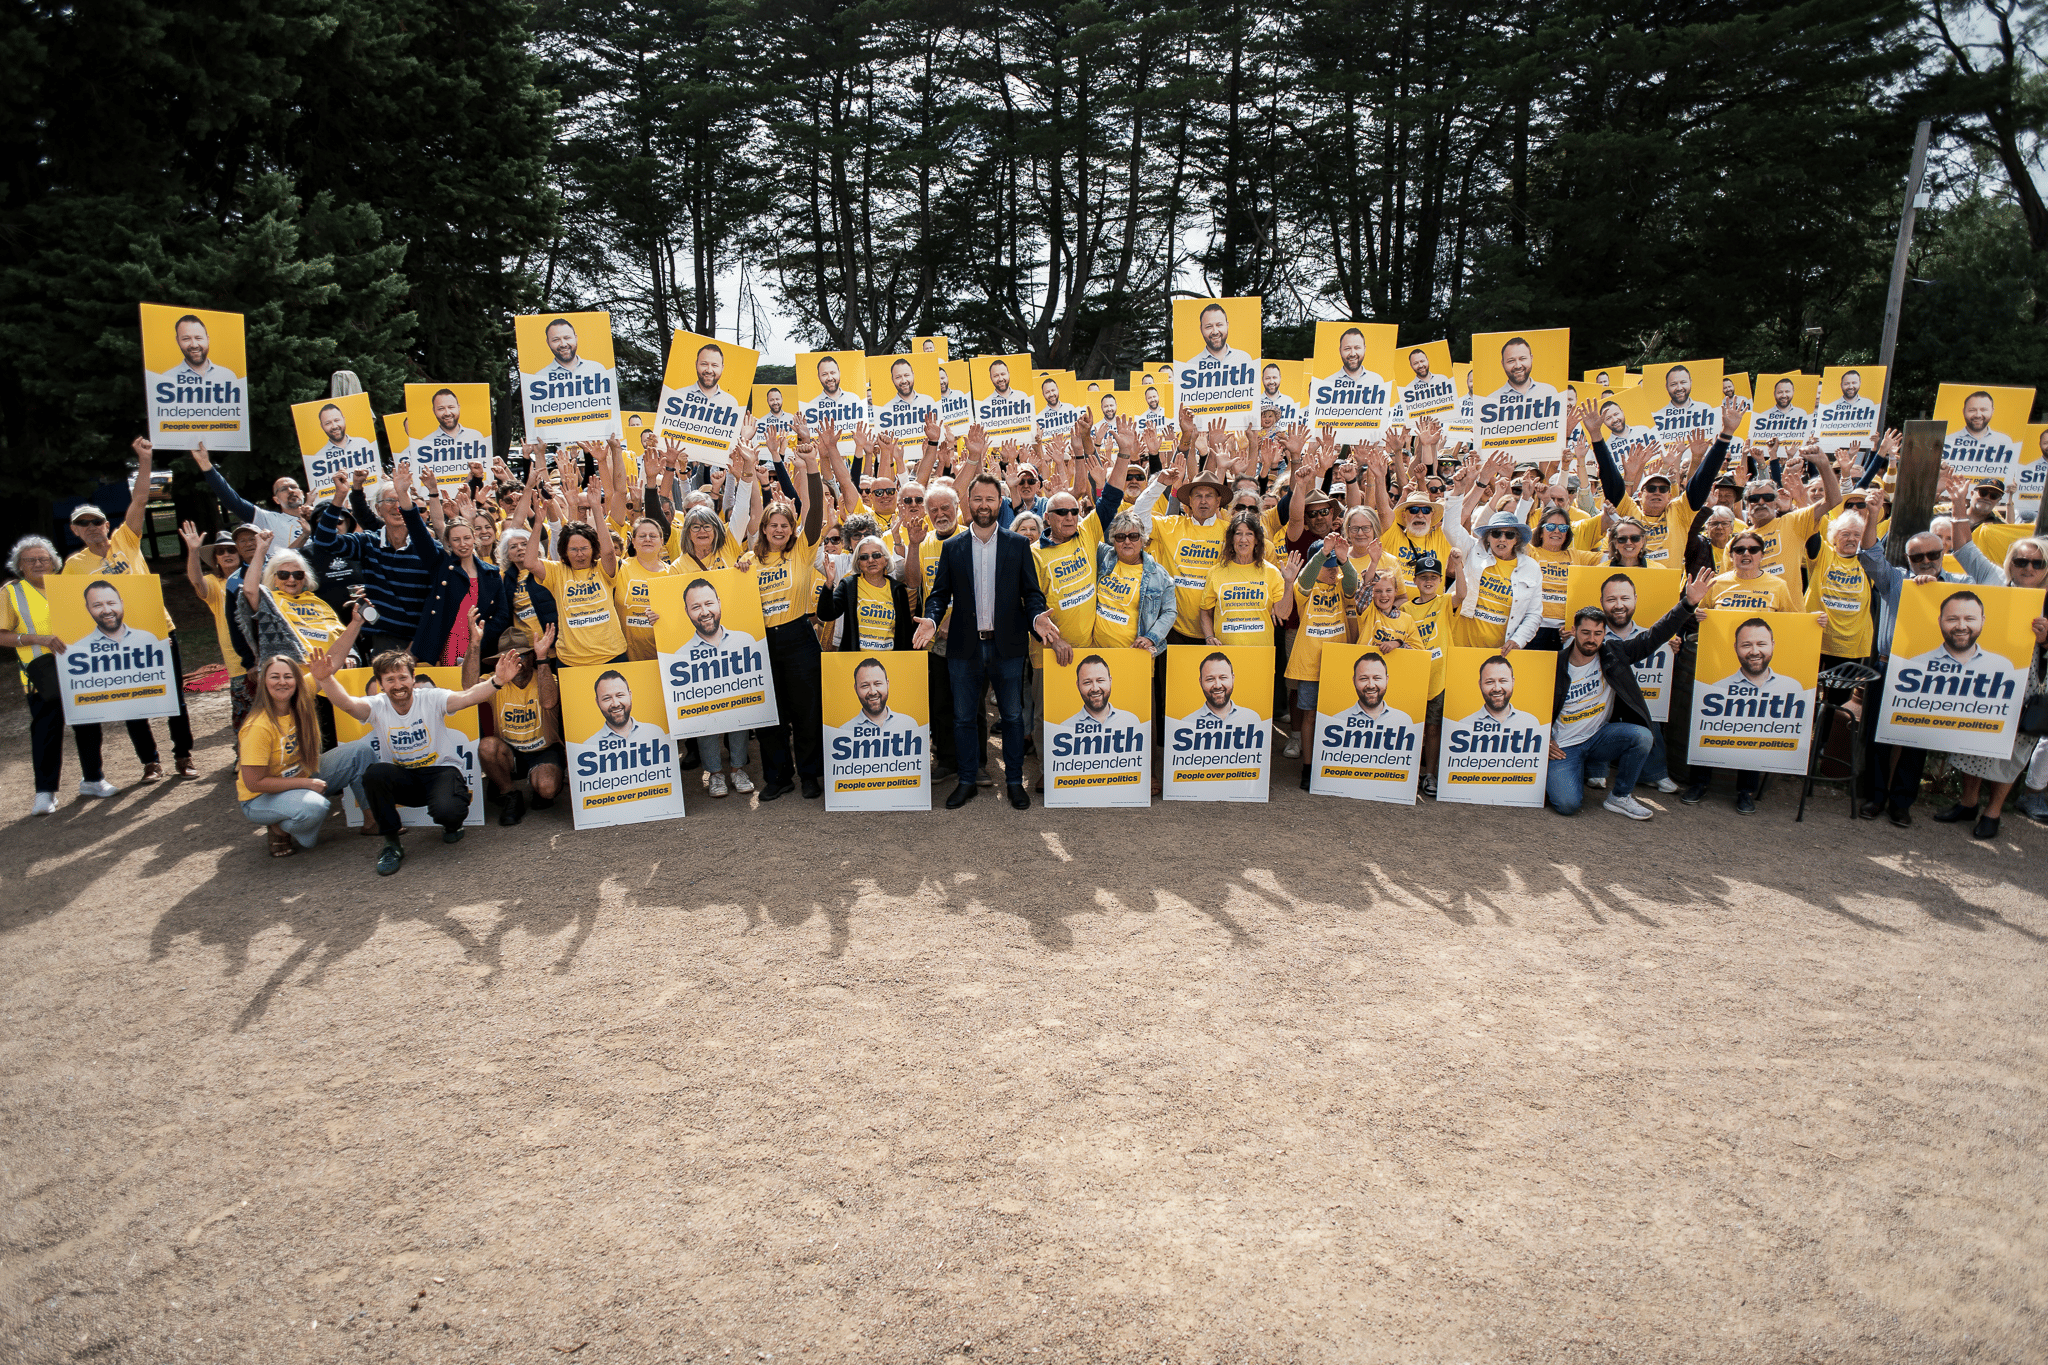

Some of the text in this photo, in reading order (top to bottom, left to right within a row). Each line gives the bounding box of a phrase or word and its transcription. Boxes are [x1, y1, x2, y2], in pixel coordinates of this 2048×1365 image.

[1199, 361, 1221, 370] Ben
[177, 374, 202, 384] Ben
[549, 372, 573, 381] Ben
[1180, 363, 1255, 389] Smith
[1334, 379, 1355, 388] Ben
[156, 381, 241, 404] Smith
[530, 373, 610, 401] Smith
[1404, 381, 1453, 403] Smith
[1414, 382, 1429, 390] Ben
[686, 393, 708, 405] Ben
[991, 398, 1007, 406] Ben
[1180, 387, 1254, 402] Independent
[1316, 384, 1385, 405] Smith
[1500, 394, 1524, 404] Ben
[531, 396, 611, 413] Independent
[819, 401, 836, 409] Ben
[893, 404, 911, 412] Ben
[980, 399, 1031, 419] Smith
[1225, 404, 1250, 412] politics
[1406, 395, 1454, 411] Independent
[1480, 396, 1560, 423] Smith
[157, 406, 241, 419] Independent
[537, 417, 563, 425] People
[581, 413, 609, 421] politics
[664, 397, 739, 427] Smith
[805, 402, 863, 424] Smith
[879, 404, 938, 428] Smith
[1315, 406, 1383, 417] Independent
[1666, 408, 1685, 416] Ben
[1821, 406, 1875, 421] Smith
[662, 416, 734, 439] Independent
[981, 415, 1031, 428] Independent
[1035, 410, 1078, 431] Smith
[1480, 419, 1559, 436] Independent
[1653, 409, 1714, 432] Smith
[1754, 416, 1808, 430] Smith
[1820, 421, 1873, 429] Independent
[434, 438, 455, 446] Ben
[663, 431, 686, 440] People
[702, 440, 727, 449] politics
[1527, 436, 1555, 444] politics
[1753, 431, 1806, 439] Independent
[1954, 438, 1978, 447] Ben
[417, 440, 487, 463] Smith
[1610, 438, 1628, 450] Ben
[325, 449, 345, 459] Ben
[1940, 444, 2013, 463] Smith
[312, 447, 375, 477] Smith
[1180, 546, 1218, 559] Smith
[1054, 556, 1087, 578] Smith
[1827, 571, 1861, 584] Smith
[567, 582, 601, 596] Smith
[1480, 576, 1513, 597] Smith
[1223, 589, 1264, 600] Smith
[1721, 597, 1766, 608] Smith
[569, 614, 609, 626] #FlipFlinders
[90, 642, 119, 653] Ben
[690, 647, 718, 661] Ben
[68, 644, 164, 675] Smith
[670, 646, 762, 686] Smith
[1927, 660, 1963, 673] Ben
[71, 669, 166, 690] Independent
[1894, 668, 2015, 700] Smith
[78, 694, 109, 703] People
[132, 688, 163, 698] politics
[673, 674, 764, 702] Independent
[1728, 685, 1759, 696] Ben
[680, 695, 762, 716] People over politics
[1701, 692, 1805, 719] Smith
[1891, 695, 2009, 716] Independent
[1563, 706, 1605, 722] #FlipFlinders
[1075, 723, 1102, 734] Ben
[1196, 719, 1223, 729] Ben
[1347, 717, 1374, 728] Ben
[1473, 721, 1501, 732] Ben
[1699, 719, 1802, 734] Independent
[1895, 715, 1931, 724] People
[1957, 722, 1999, 731] politics
[390, 729, 426, 744] Smith
[854, 726, 880, 737] Ben
[1172, 724, 1264, 751] Smith
[1322, 724, 1415, 751] Smith
[599, 738, 627, 751] Ben
[832, 730, 922, 760] Smith
[1052, 726, 1143, 757] Smith
[1449, 728, 1542, 753] Smith
[1703, 738, 1735, 746] People
[577, 738, 670, 776] Smith
[1052, 755, 1142, 772] Independent
[1172, 752, 1262, 767] Independent
[1321, 750, 1412, 766] Independent
[1447, 756, 1539, 770] Independent
[832, 759, 922, 776] Independent
[1324, 768, 1353, 776] People
[579, 766, 672, 792] Independent
[1057, 778, 1086, 786] People
[1107, 775, 1138, 784] politics
[1176, 772, 1205, 780] People
[1226, 771, 1257, 779] politics
[1451, 774, 1480, 782] People
[1501, 775, 1533, 783] politics
[838, 781, 866, 790] People
[887, 779, 917, 788] politics
[586, 787, 669, 806] People over politics
